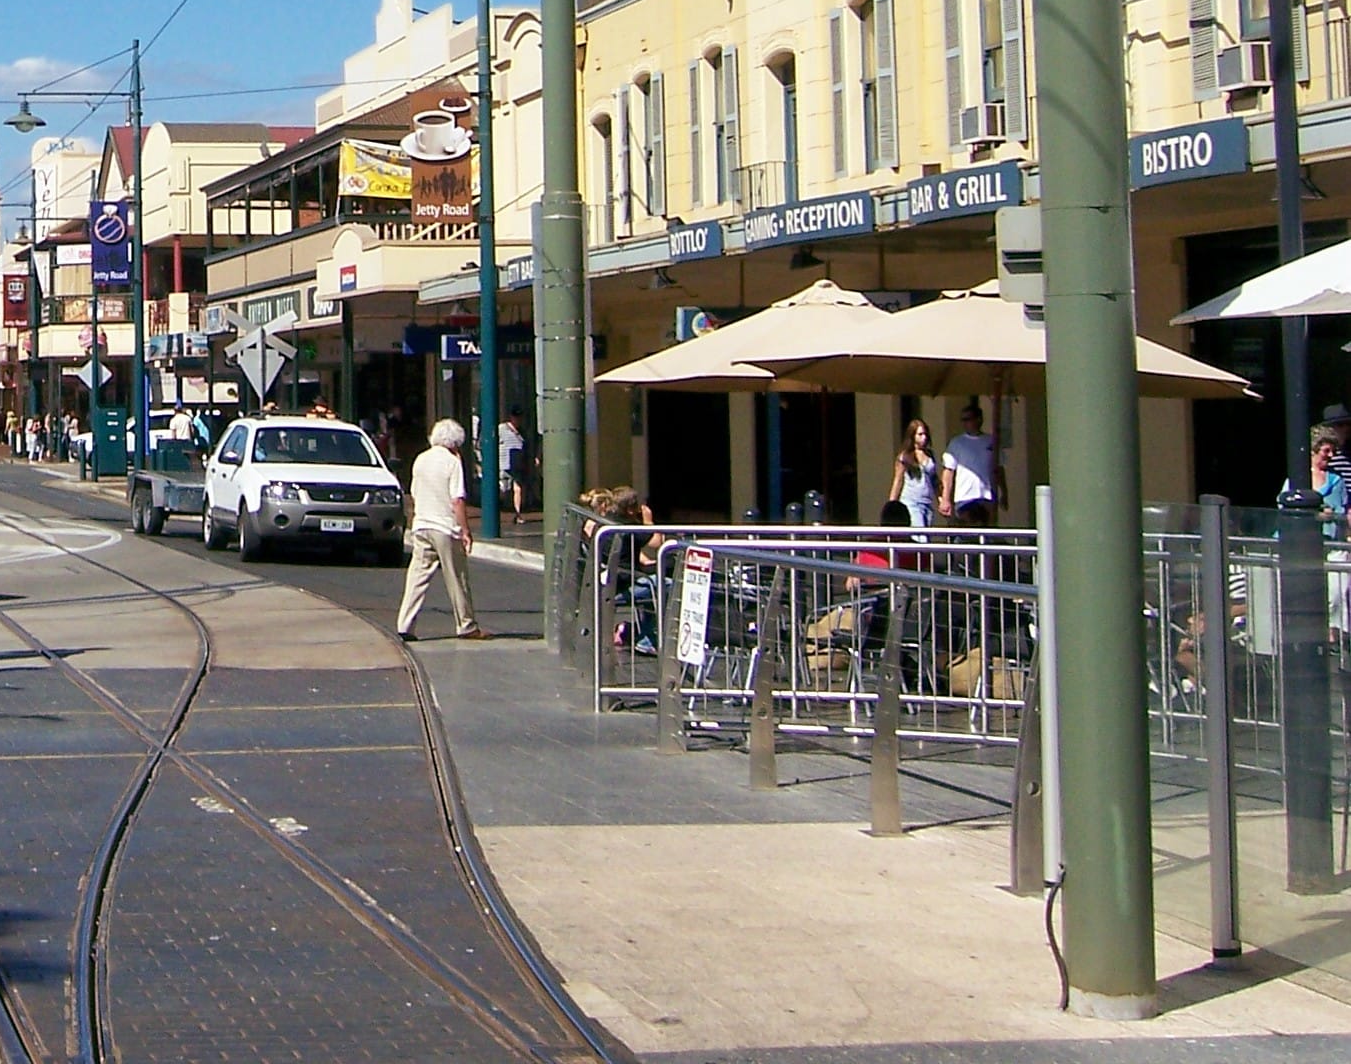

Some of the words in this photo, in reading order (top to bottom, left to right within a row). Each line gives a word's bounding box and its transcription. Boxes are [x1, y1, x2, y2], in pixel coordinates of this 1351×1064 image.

[1142, 132, 1213, 176] BISTRO
[911, 182, 933, 216] BAR
[937, 181, 949, 209] &
[955, 172, 1008, 207] GRILL
[415, 203, 441, 218] Jetty
[443, 203, 470, 216] Road
[745, 212, 778, 243] GAMING
[785, 199, 864, 235] RECEPTION
[110, 271, 128, 280] Road
[457, 340, 483, 354] TA
